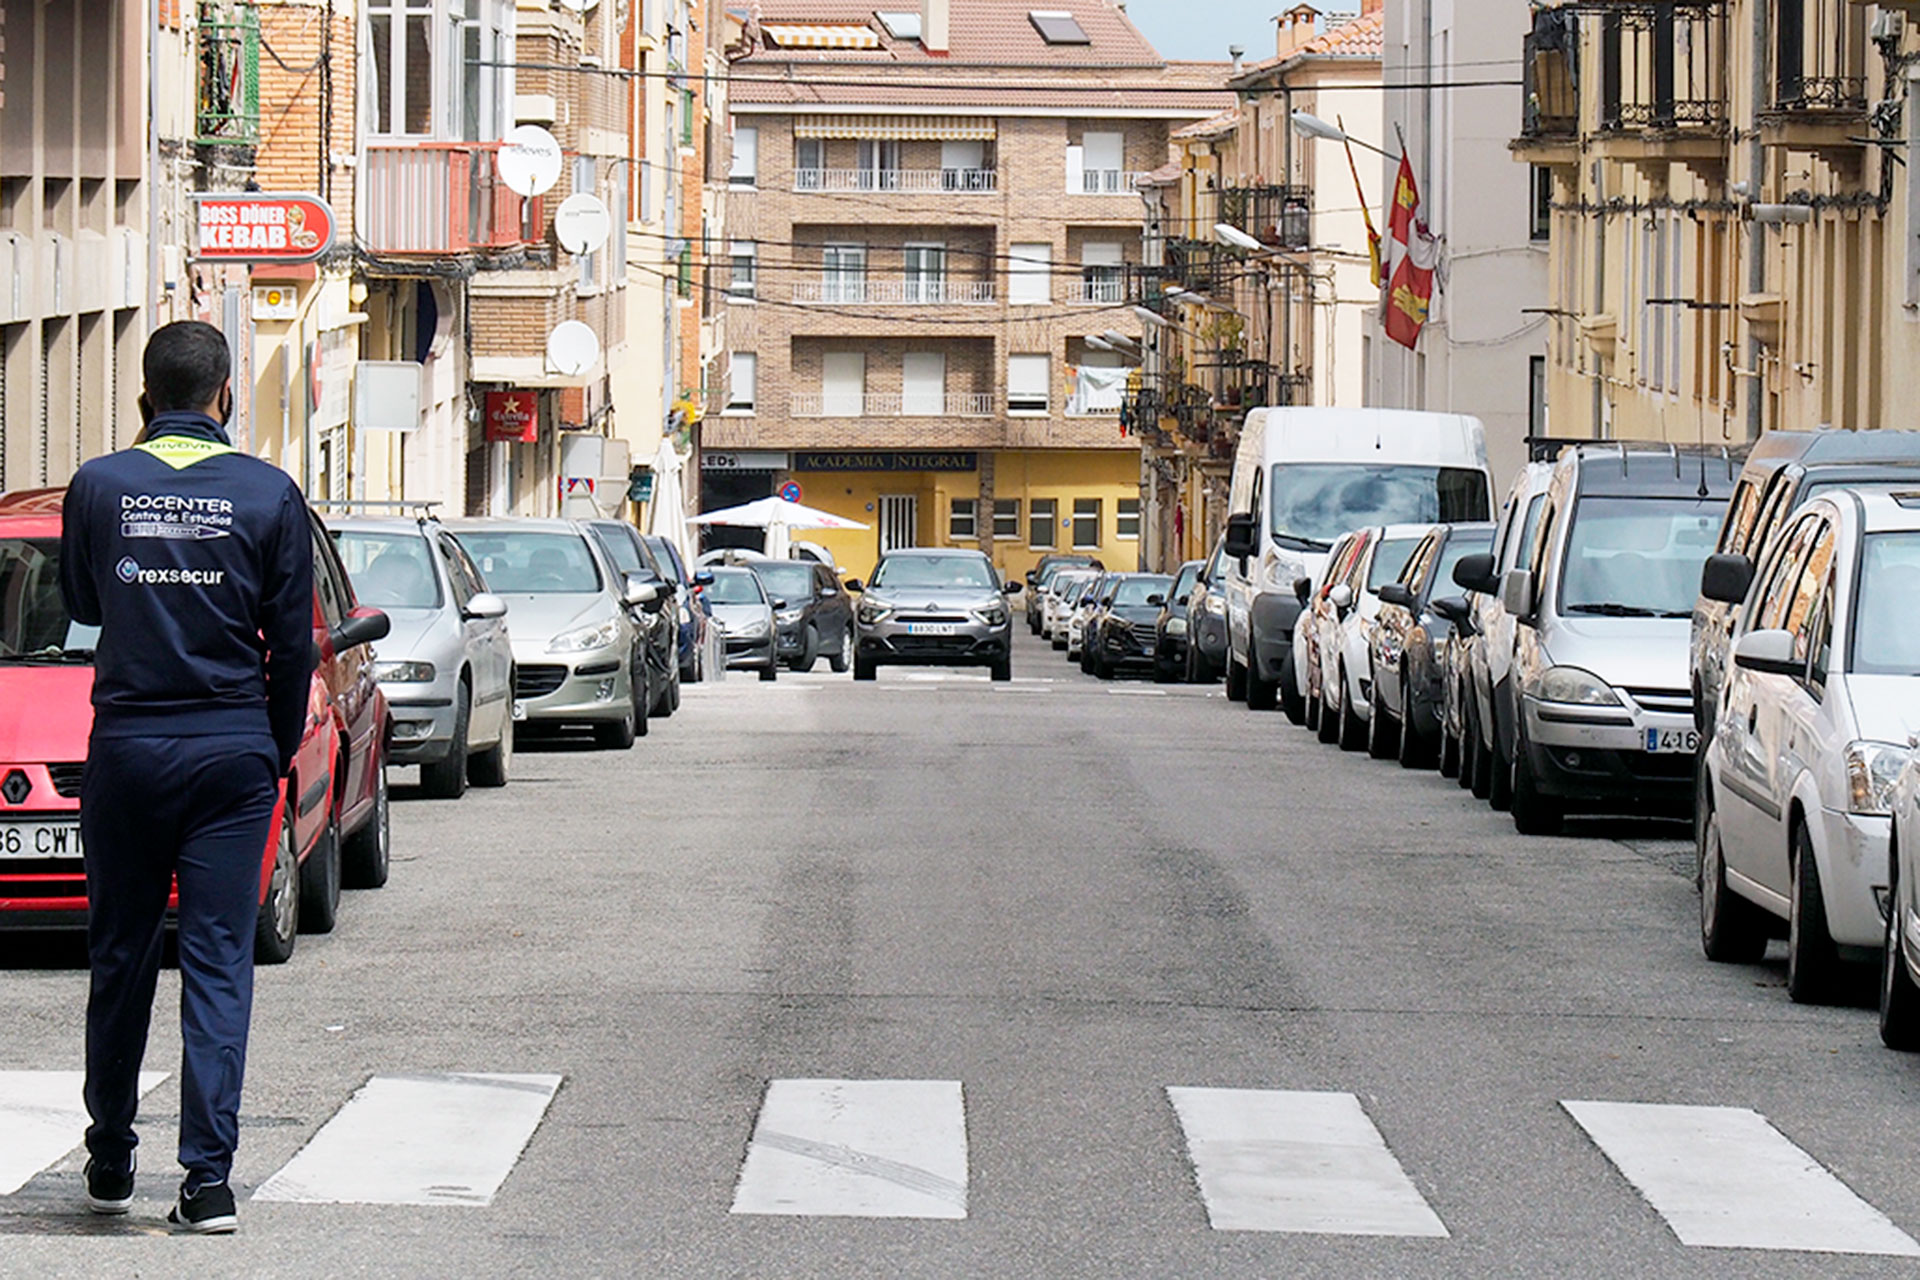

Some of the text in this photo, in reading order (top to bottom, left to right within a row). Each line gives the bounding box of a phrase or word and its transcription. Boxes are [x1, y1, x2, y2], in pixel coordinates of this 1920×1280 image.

[201, 203, 286, 224] BOSS DÖNER
[201, 225, 287, 248] KEBAB
[805, 452, 969, 470] ACADEMIA INTEGRAL
[121, 494, 233, 513] DOCENTER
[121, 510, 233, 526] Centro de Estudios
[35, 827, 81, 853] CWT
